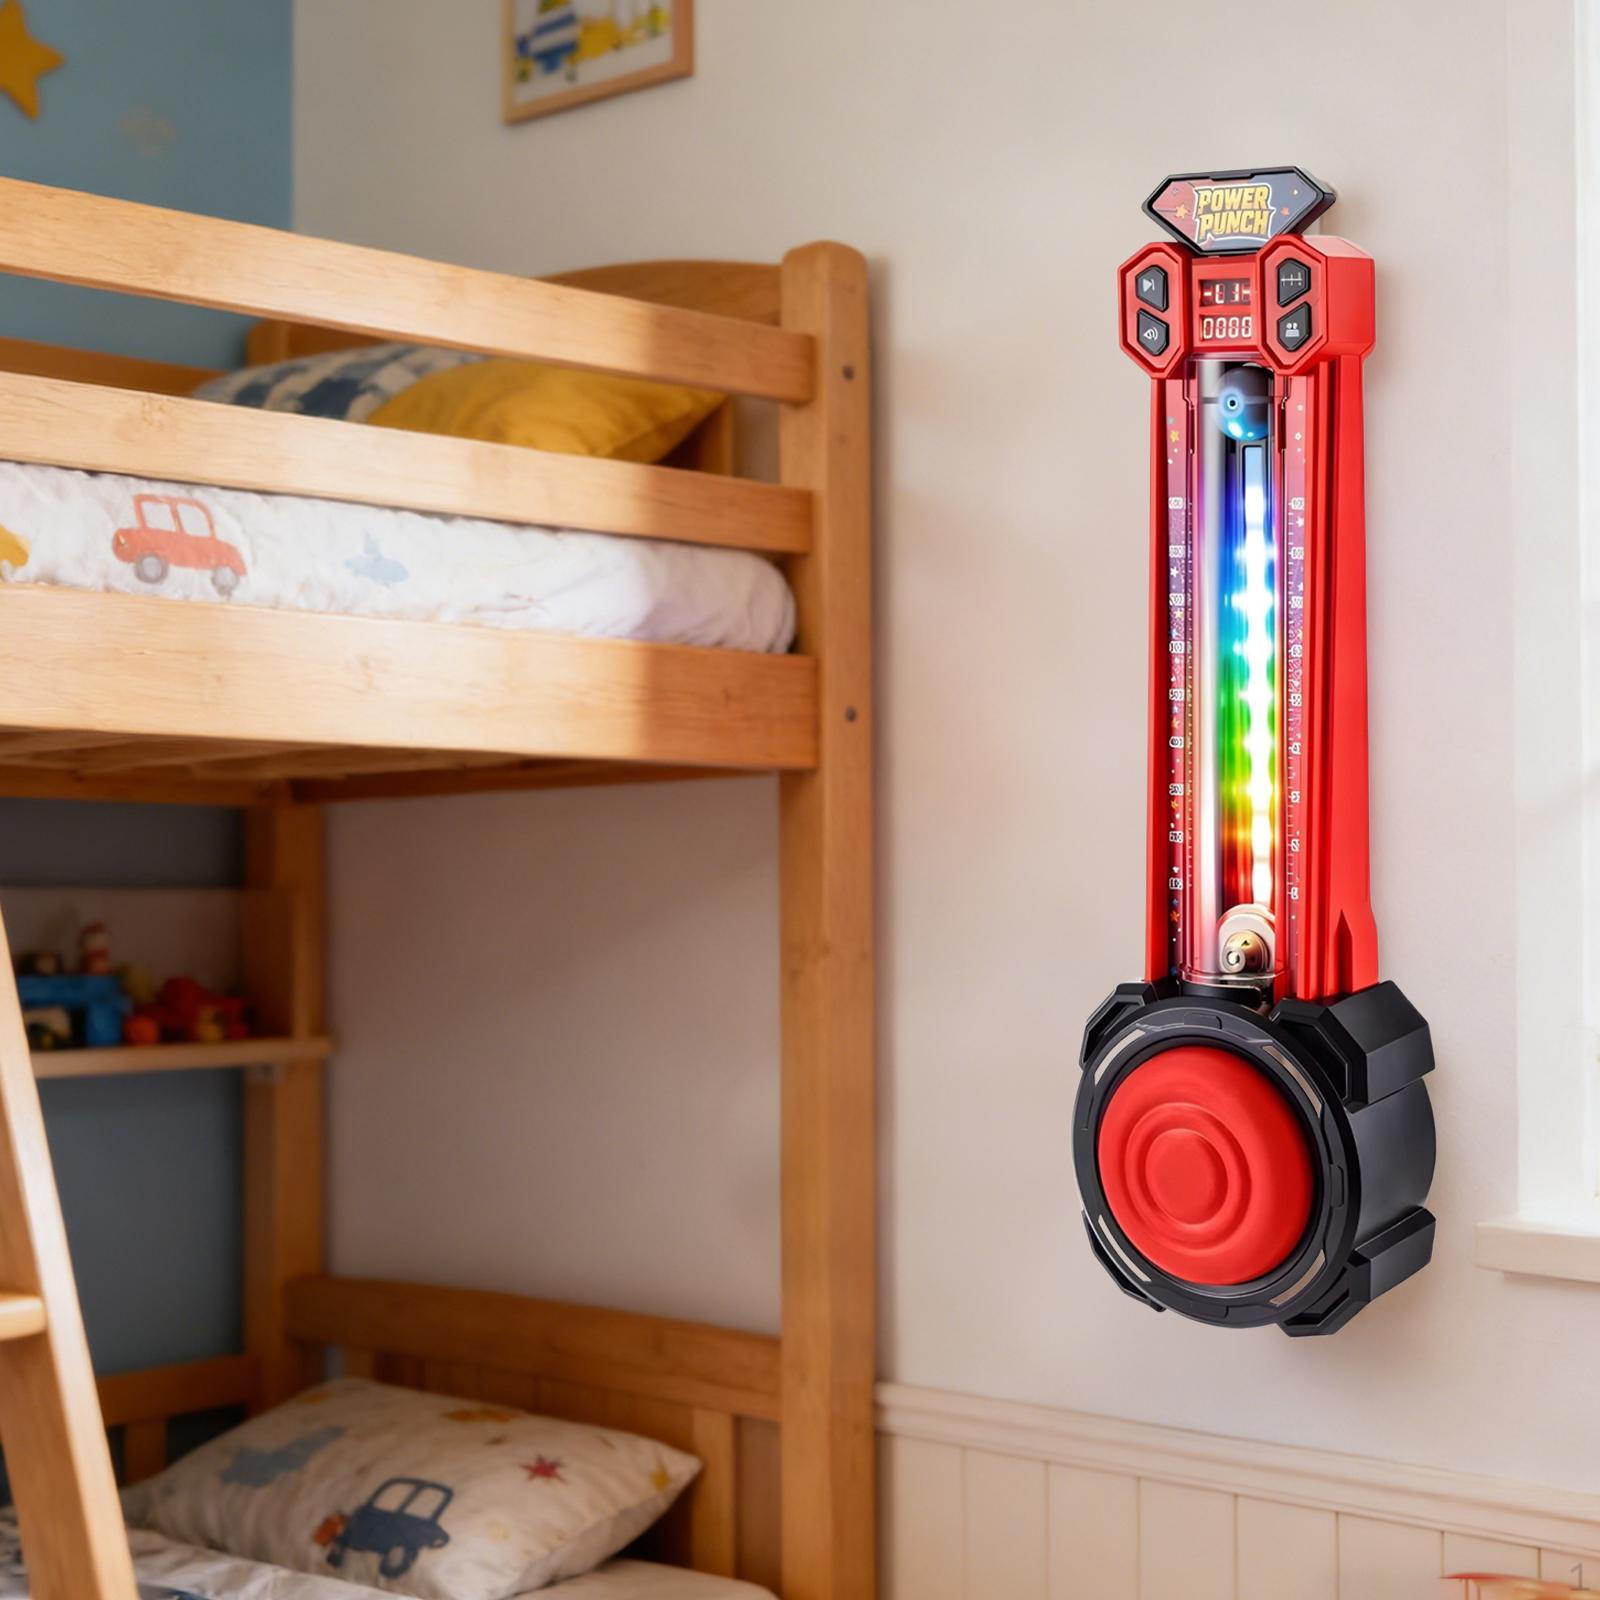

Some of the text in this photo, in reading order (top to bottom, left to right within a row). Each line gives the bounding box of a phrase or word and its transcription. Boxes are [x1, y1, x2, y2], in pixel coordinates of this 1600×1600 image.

[1198, 186, 1270, 214] POWER
[1199, 209, 1271, 240] PUNCH
[1203, 316, 1252, 340] 0000
